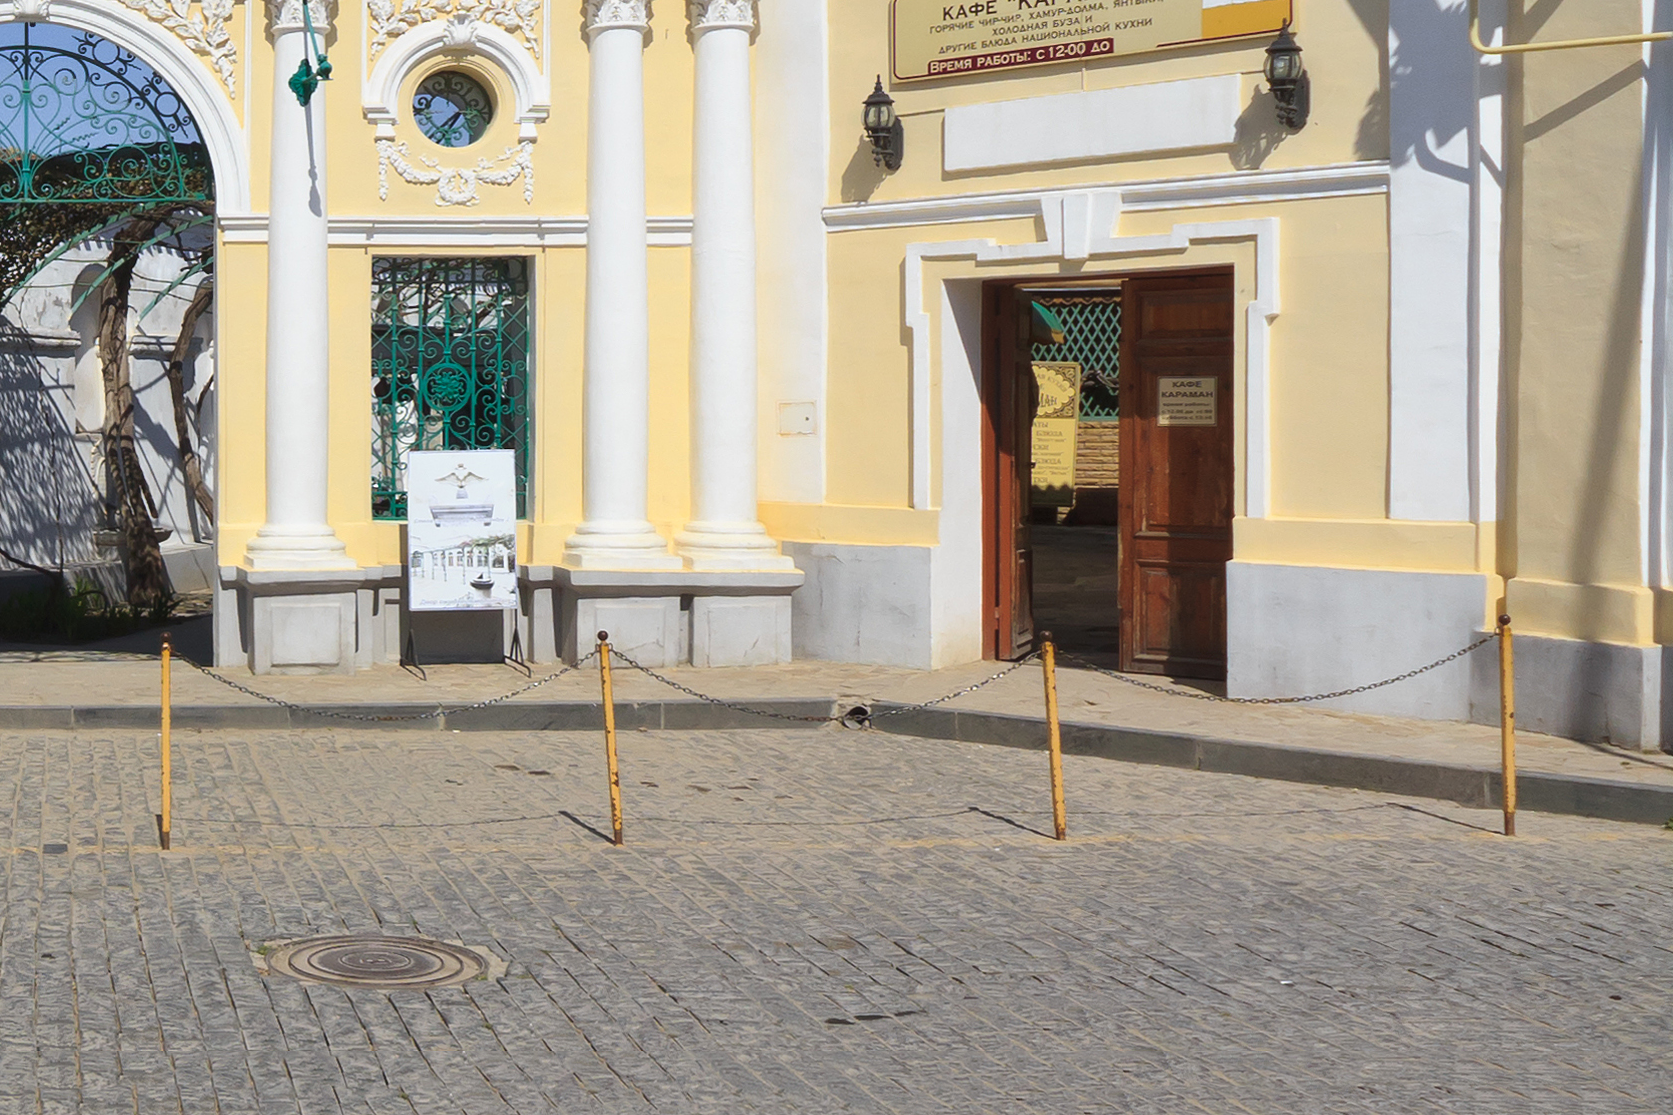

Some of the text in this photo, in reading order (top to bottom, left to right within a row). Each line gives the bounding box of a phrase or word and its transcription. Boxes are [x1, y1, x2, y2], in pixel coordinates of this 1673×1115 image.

[929, 20, 974, 34] ГОРЯЧИЕ
[979, 14, 1024, 27] ЧИР-ЧИР,
[1029, 2, 1108, 20] ХАМУР-ДОЛМА,
[943, 0, 997, 21] КАФЕ
[992, 15, 1093, 36] ХОЛОДНАЯ БУЗА И
[938, 18, 1153, 55] ДРУГИЕ БЛЮДА НАЦИОНАЛЬНОЙ КУХНИ
[930, 58, 972, 73] ВРЕМЯ
[977, 51, 1031, 67] РАБОТЫ:
[1049, 42, 1086, 58] 12-00
[1091, 41, 1110, 53] ДО
[1161, 390, 1214, 398] КАРАМАН
[1172, 380, 1202, 388] КАФЕ
